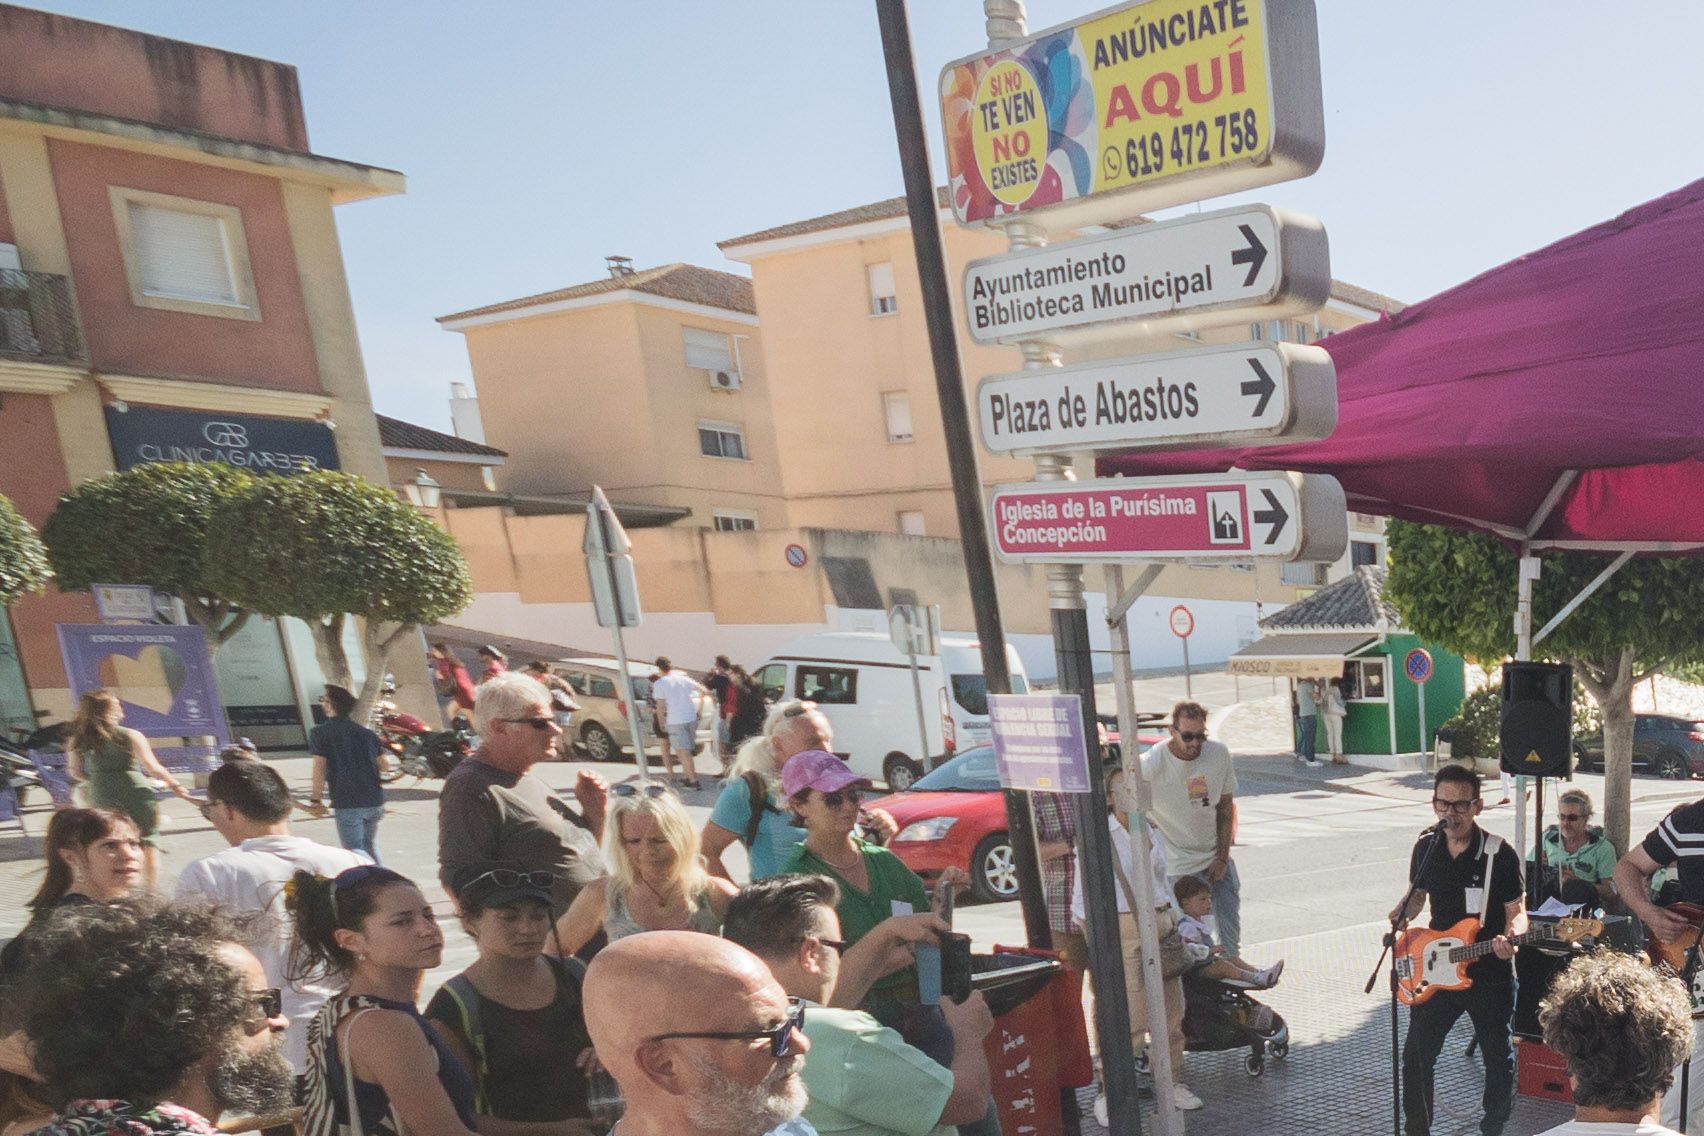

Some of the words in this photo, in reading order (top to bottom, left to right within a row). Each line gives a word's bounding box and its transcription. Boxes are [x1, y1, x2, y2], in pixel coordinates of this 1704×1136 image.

[1093, 0, 1250, 71] ANÚNCIATE
[990, 74, 1003, 97] SI
[1003, 69, 1022, 91] NO
[1104, 35, 1247, 129] AQUÍ
[980, 96, 1001, 132] TE
[1002, 89, 1036, 124] VEN
[993, 130, 1031, 163] NO
[1126, 132, 1164, 178] 619
[1170, 120, 1210, 166] 472
[1214, 108, 1259, 154] 758
[990, 157, 1039, 191] EXISTES
[972, 252, 1126, 302] Ayuntamiento
[975, 291, 1085, 329] Biblioteca
[1091, 264, 1213, 310] Municipal
[990, 392, 1051, 436] Plaza
[1058, 386, 1087, 429] de
[1095, 377, 1200, 426] Abastos
[1000, 498, 1057, 526] Iglesia
[1062, 498, 1085, 518] de
[1089, 497, 1106, 518] la
[1110, 493, 1197, 518] Purísima
[1003, 521, 1107, 547] Concepción
[1230, 660, 1271, 673] KIOSCO
